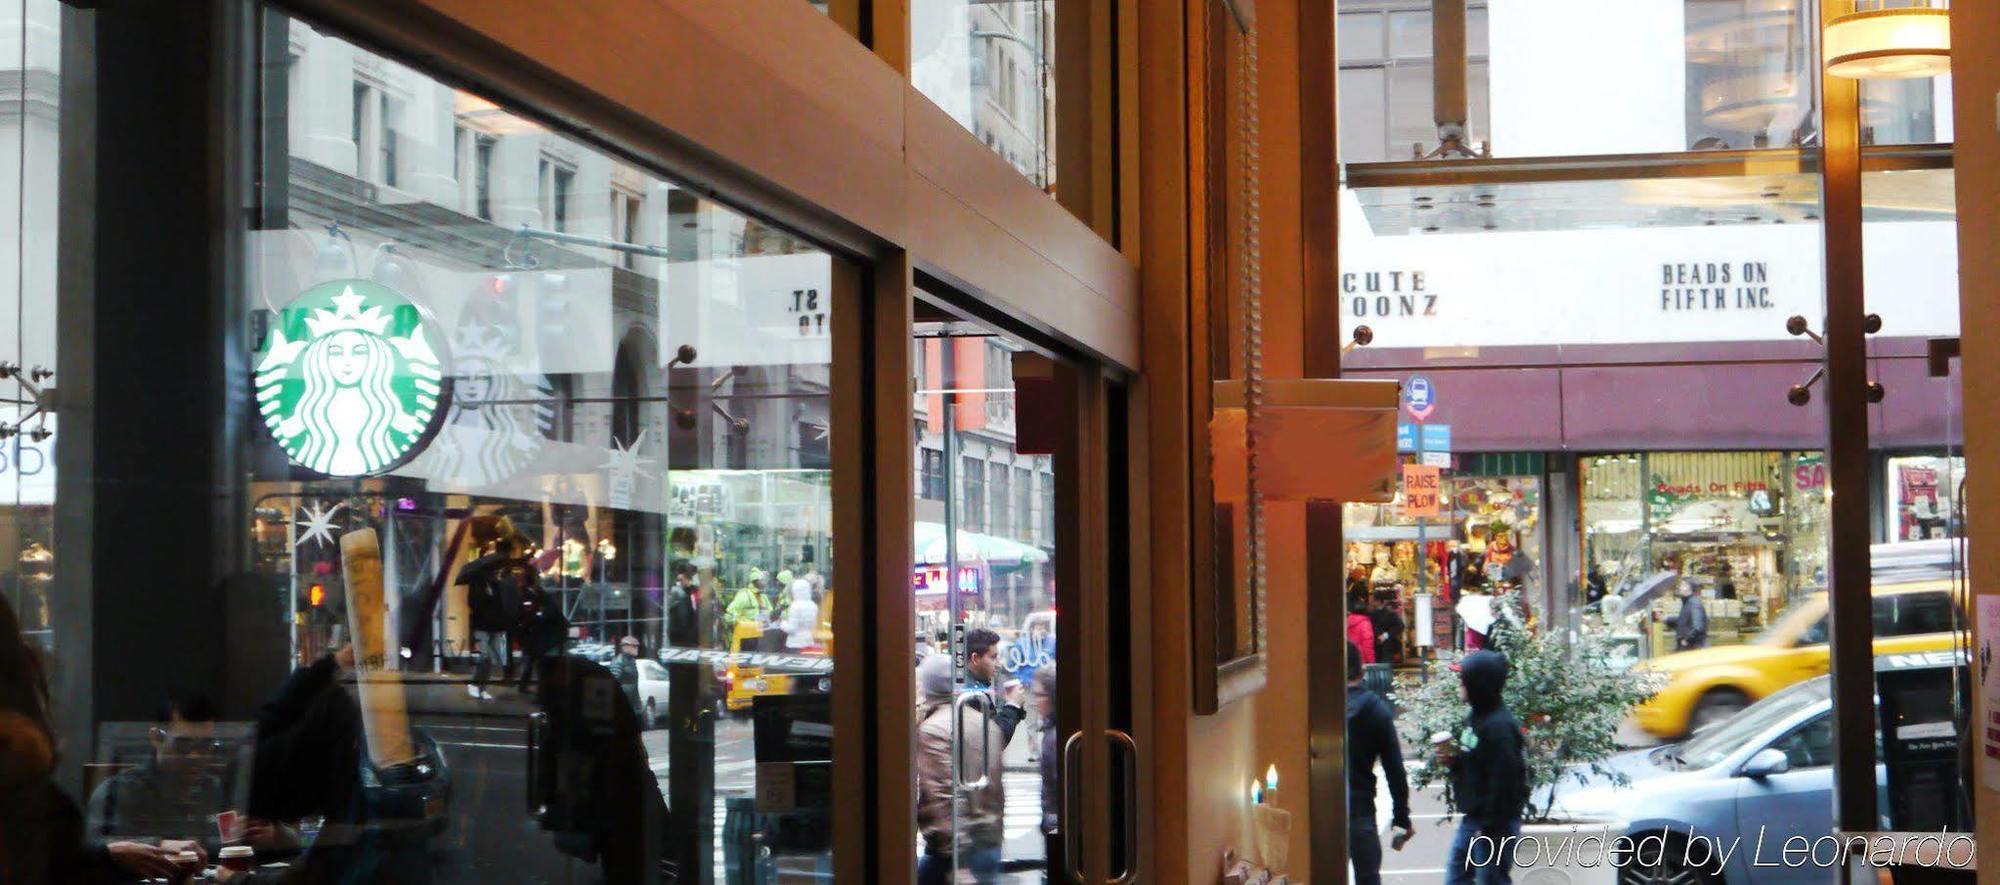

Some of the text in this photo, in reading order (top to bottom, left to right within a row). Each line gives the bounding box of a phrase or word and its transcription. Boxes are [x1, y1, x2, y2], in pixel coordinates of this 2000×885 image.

[1343, 271, 1425, 293] CUTE
[1662, 262, 1767, 285] BEADS ON
[1341, 294, 1439, 317] OONZ
[1661, 286, 1775, 310] FIFTH INC.
[1406, 474, 1437, 489] RAISE
